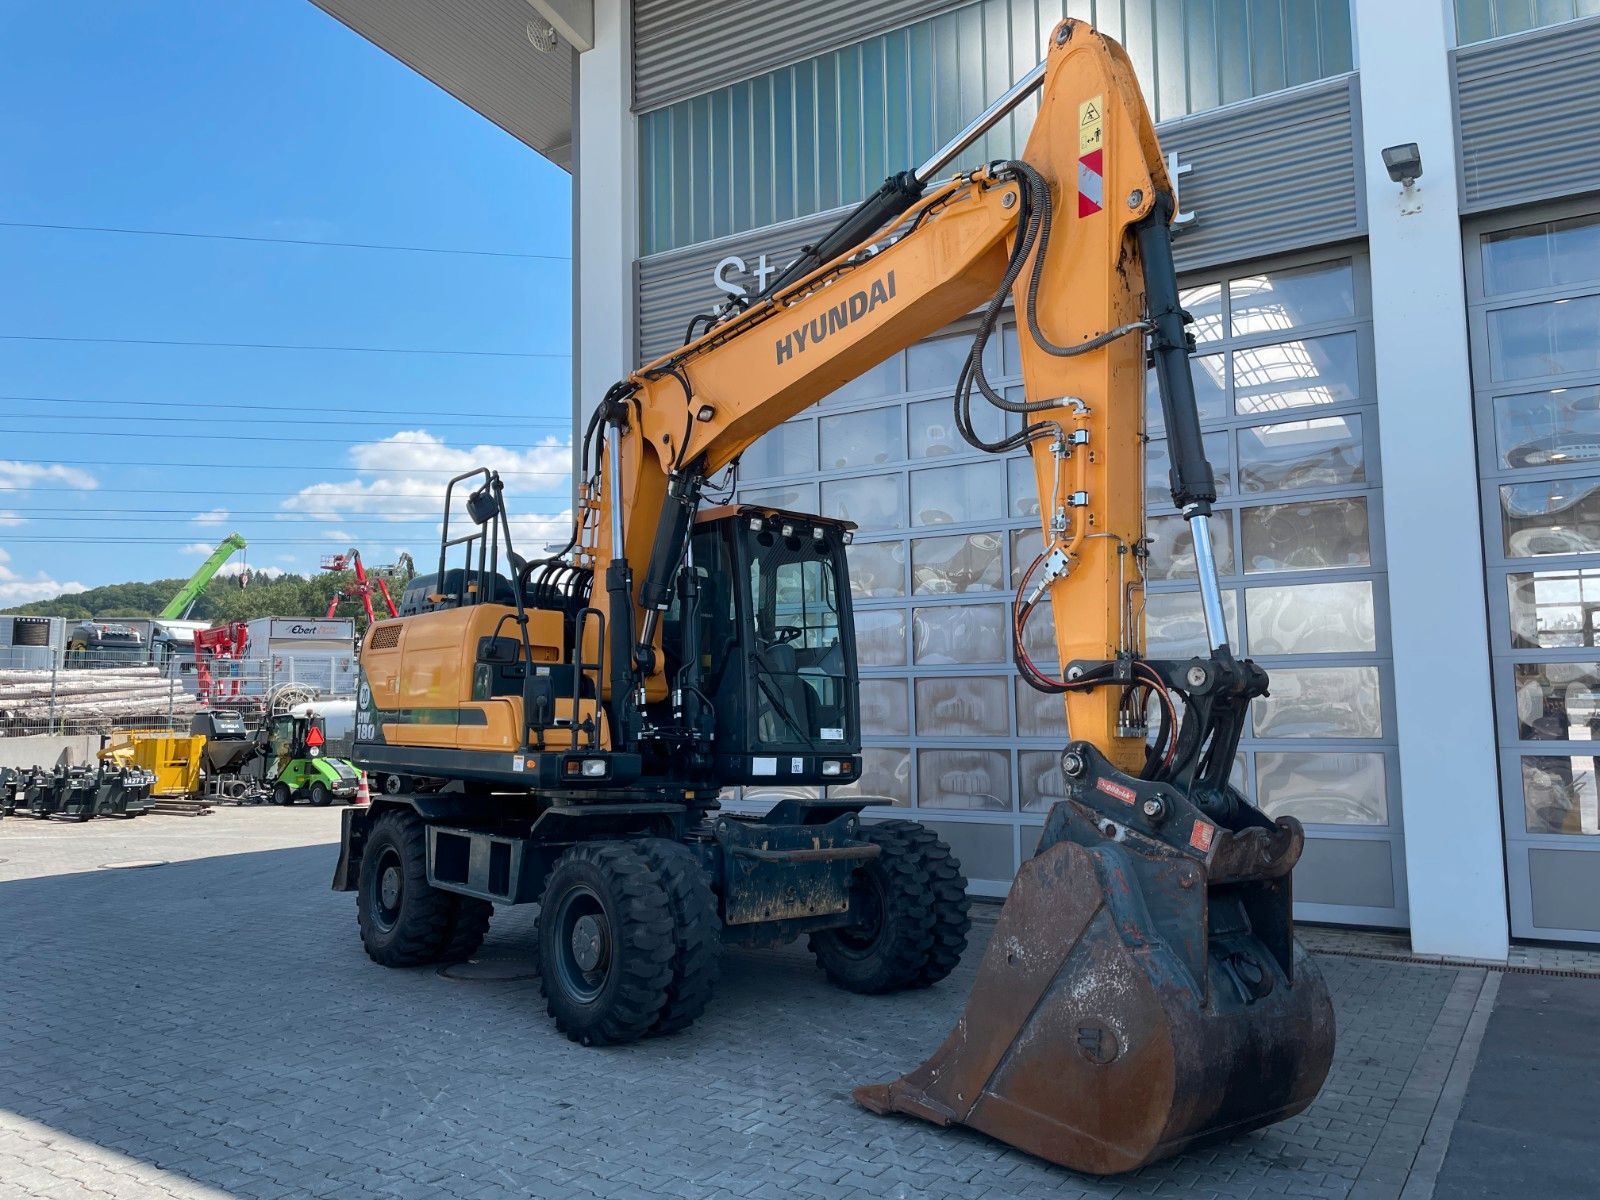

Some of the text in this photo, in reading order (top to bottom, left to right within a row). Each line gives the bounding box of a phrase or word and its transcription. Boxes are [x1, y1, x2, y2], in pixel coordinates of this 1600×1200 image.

[775, 269, 897, 366] HYUNDAI
[291, 624, 317, 635] Ebert
[357, 711, 371, 724] HW
[356, 723, 375, 740] 180
